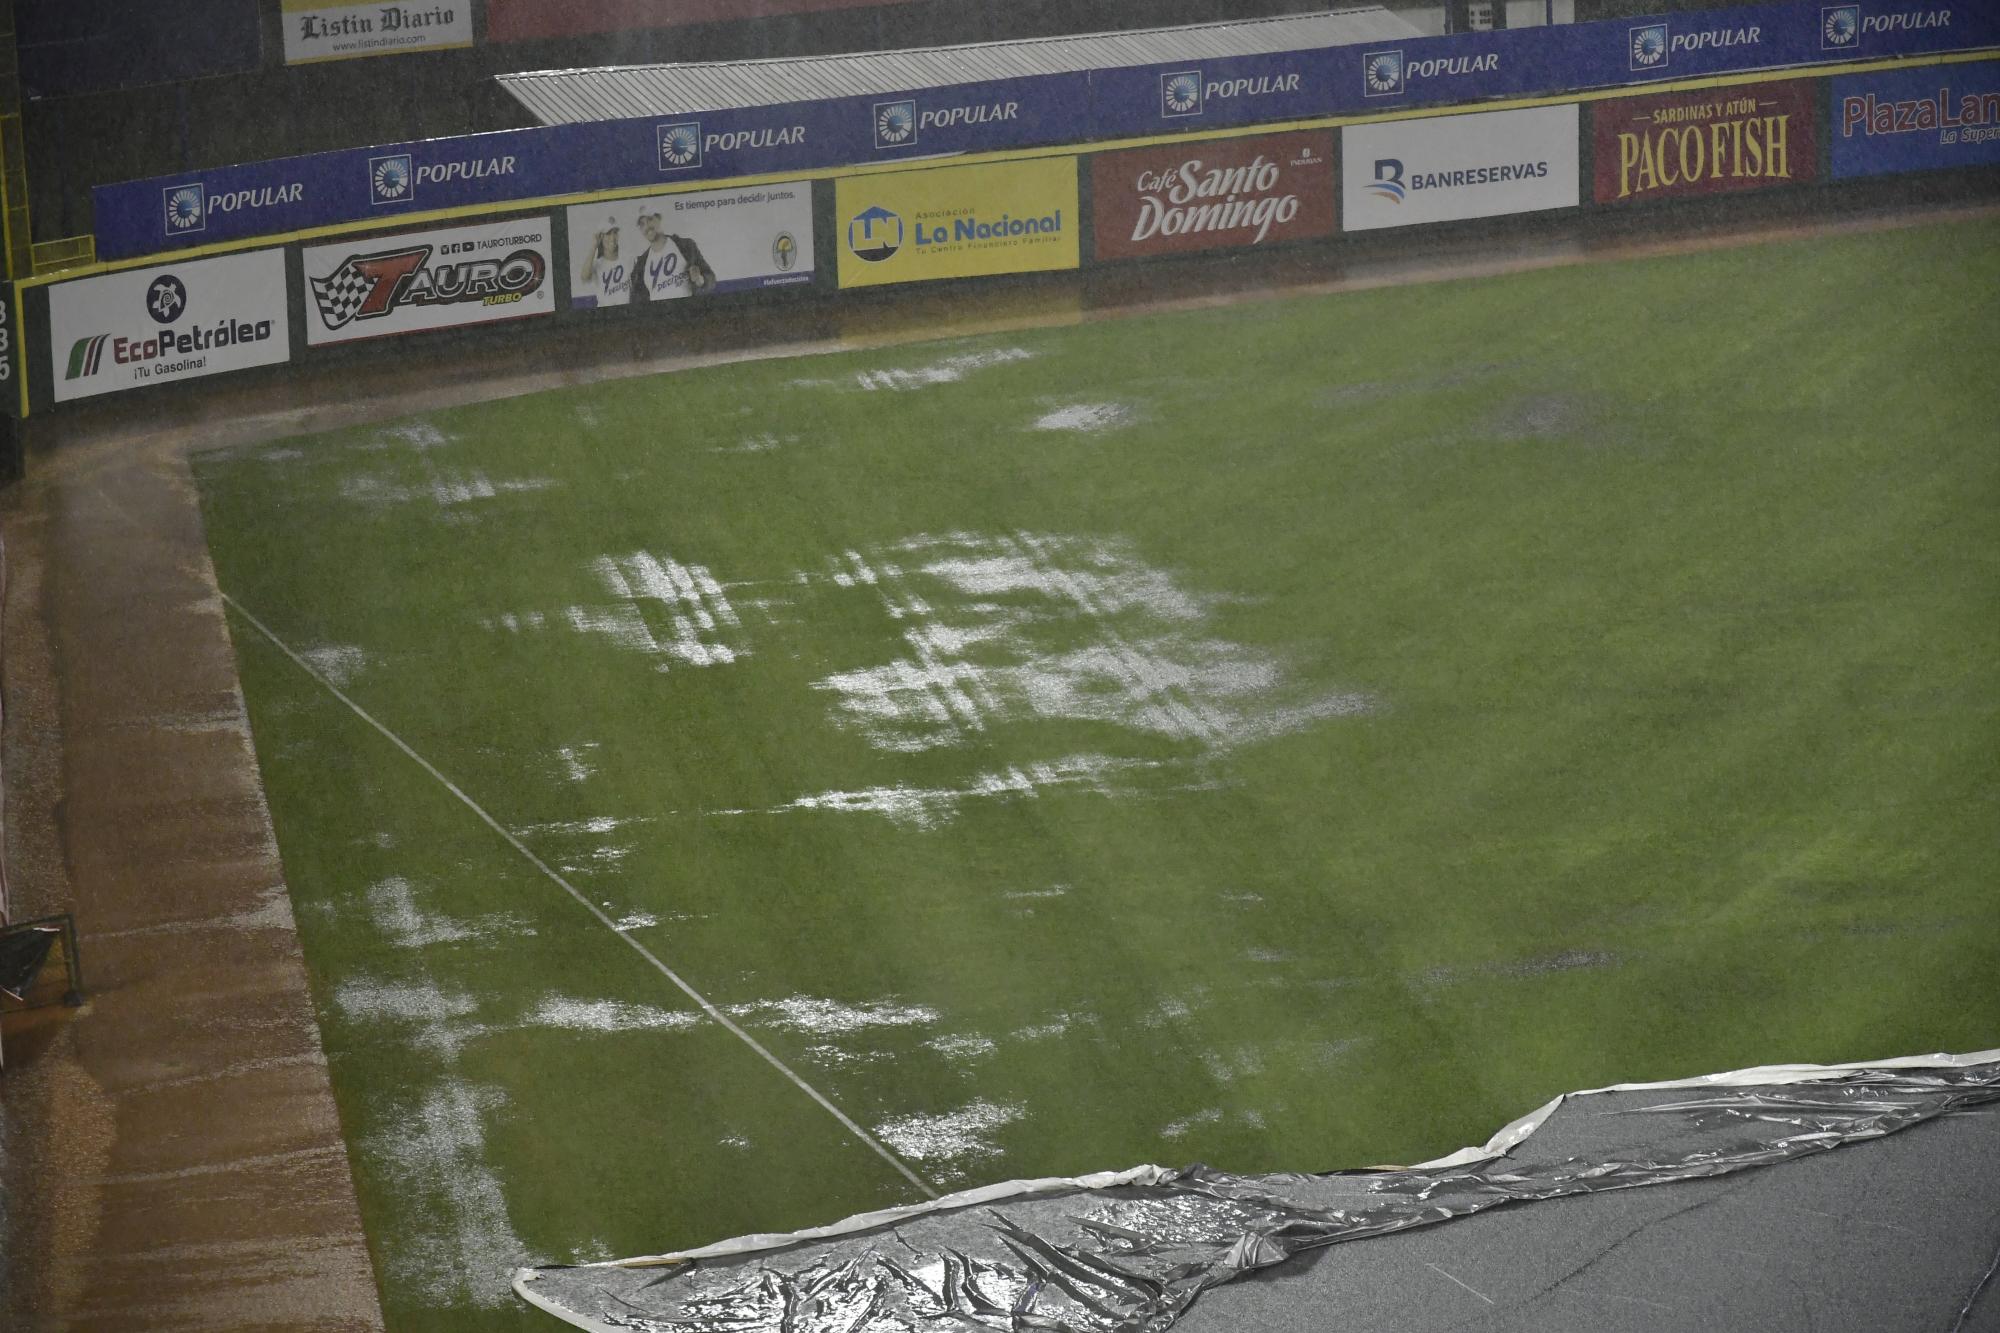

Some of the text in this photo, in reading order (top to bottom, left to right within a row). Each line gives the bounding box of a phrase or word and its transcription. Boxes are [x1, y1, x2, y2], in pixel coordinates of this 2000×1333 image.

[380, 6, 454, 32] Diario
[1863, 10, 1951, 33] POPULAR
[332, 34, 426, 51] www.listindiario.com
[1671, 26, 1760, 52] POPULAR
[1406, 54, 1498, 79] POPULAR
[1205, 73, 1300, 99] POPULAR
[920, 102, 1018, 129] POPULAR
[1653, 99, 1756, 124] SARDINAS Y ATÚN
[704, 126, 805, 152] POPULAR
[1940, 129, 1956, 144] La
[1617, 115, 1791, 198] PACO FISH
[416, 156, 515, 184] POPULAR
[1137, 156, 1279, 204] Café Santo
[1411, 162, 1547, 191] BANRESERVAS
[207, 183, 303, 214] POPULAR
[674, 201, 684, 210] Es
[686, 199, 715, 209] tiempo
[717, 198, 735, 208] para
[737, 195, 765, 204] decidir
[915, 209, 1061, 245] La Nacional
[1131, 194, 1297, 243] Domingo
[477, 234, 542, 250] TAUROTURBORD
[482, 293, 521, 306] TURBO
[114, 319, 271, 364] EcoPetróleo
[134, 357, 206, 379] ¡Tu Gasolina!
